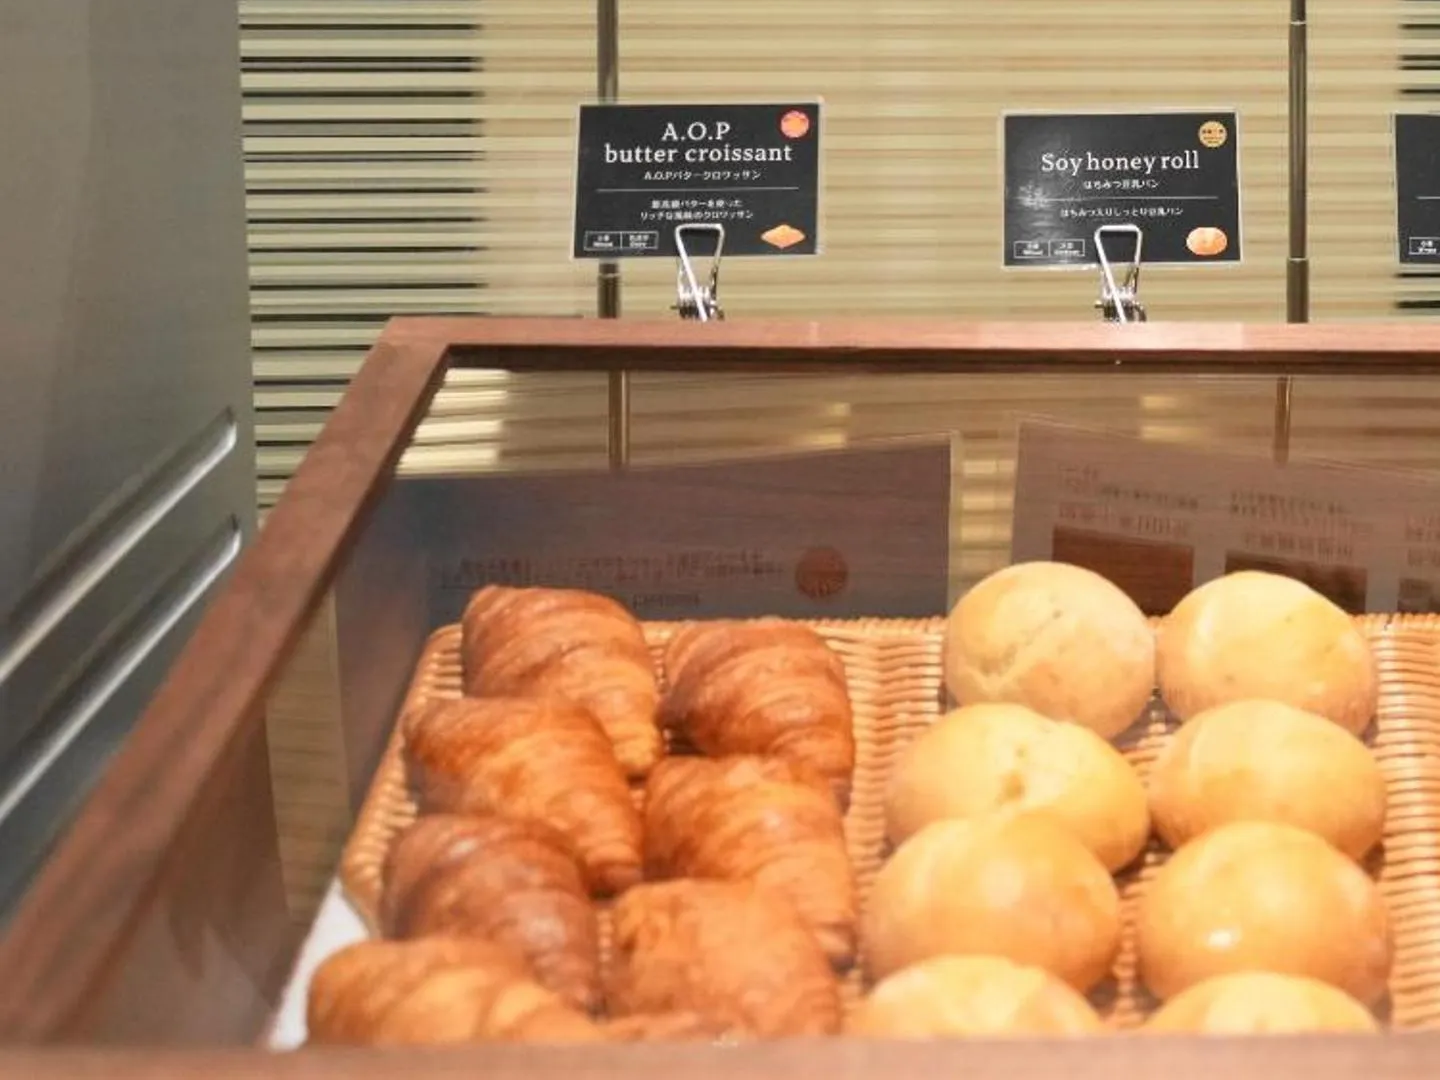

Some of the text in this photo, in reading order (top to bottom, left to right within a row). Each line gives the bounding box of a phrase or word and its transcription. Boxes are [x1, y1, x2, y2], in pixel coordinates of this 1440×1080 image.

[661, 121, 731, 142] A.O.P
[604, 143, 793, 163] butter croissant
[1041, 150, 1200, 176] Soy honey roll
